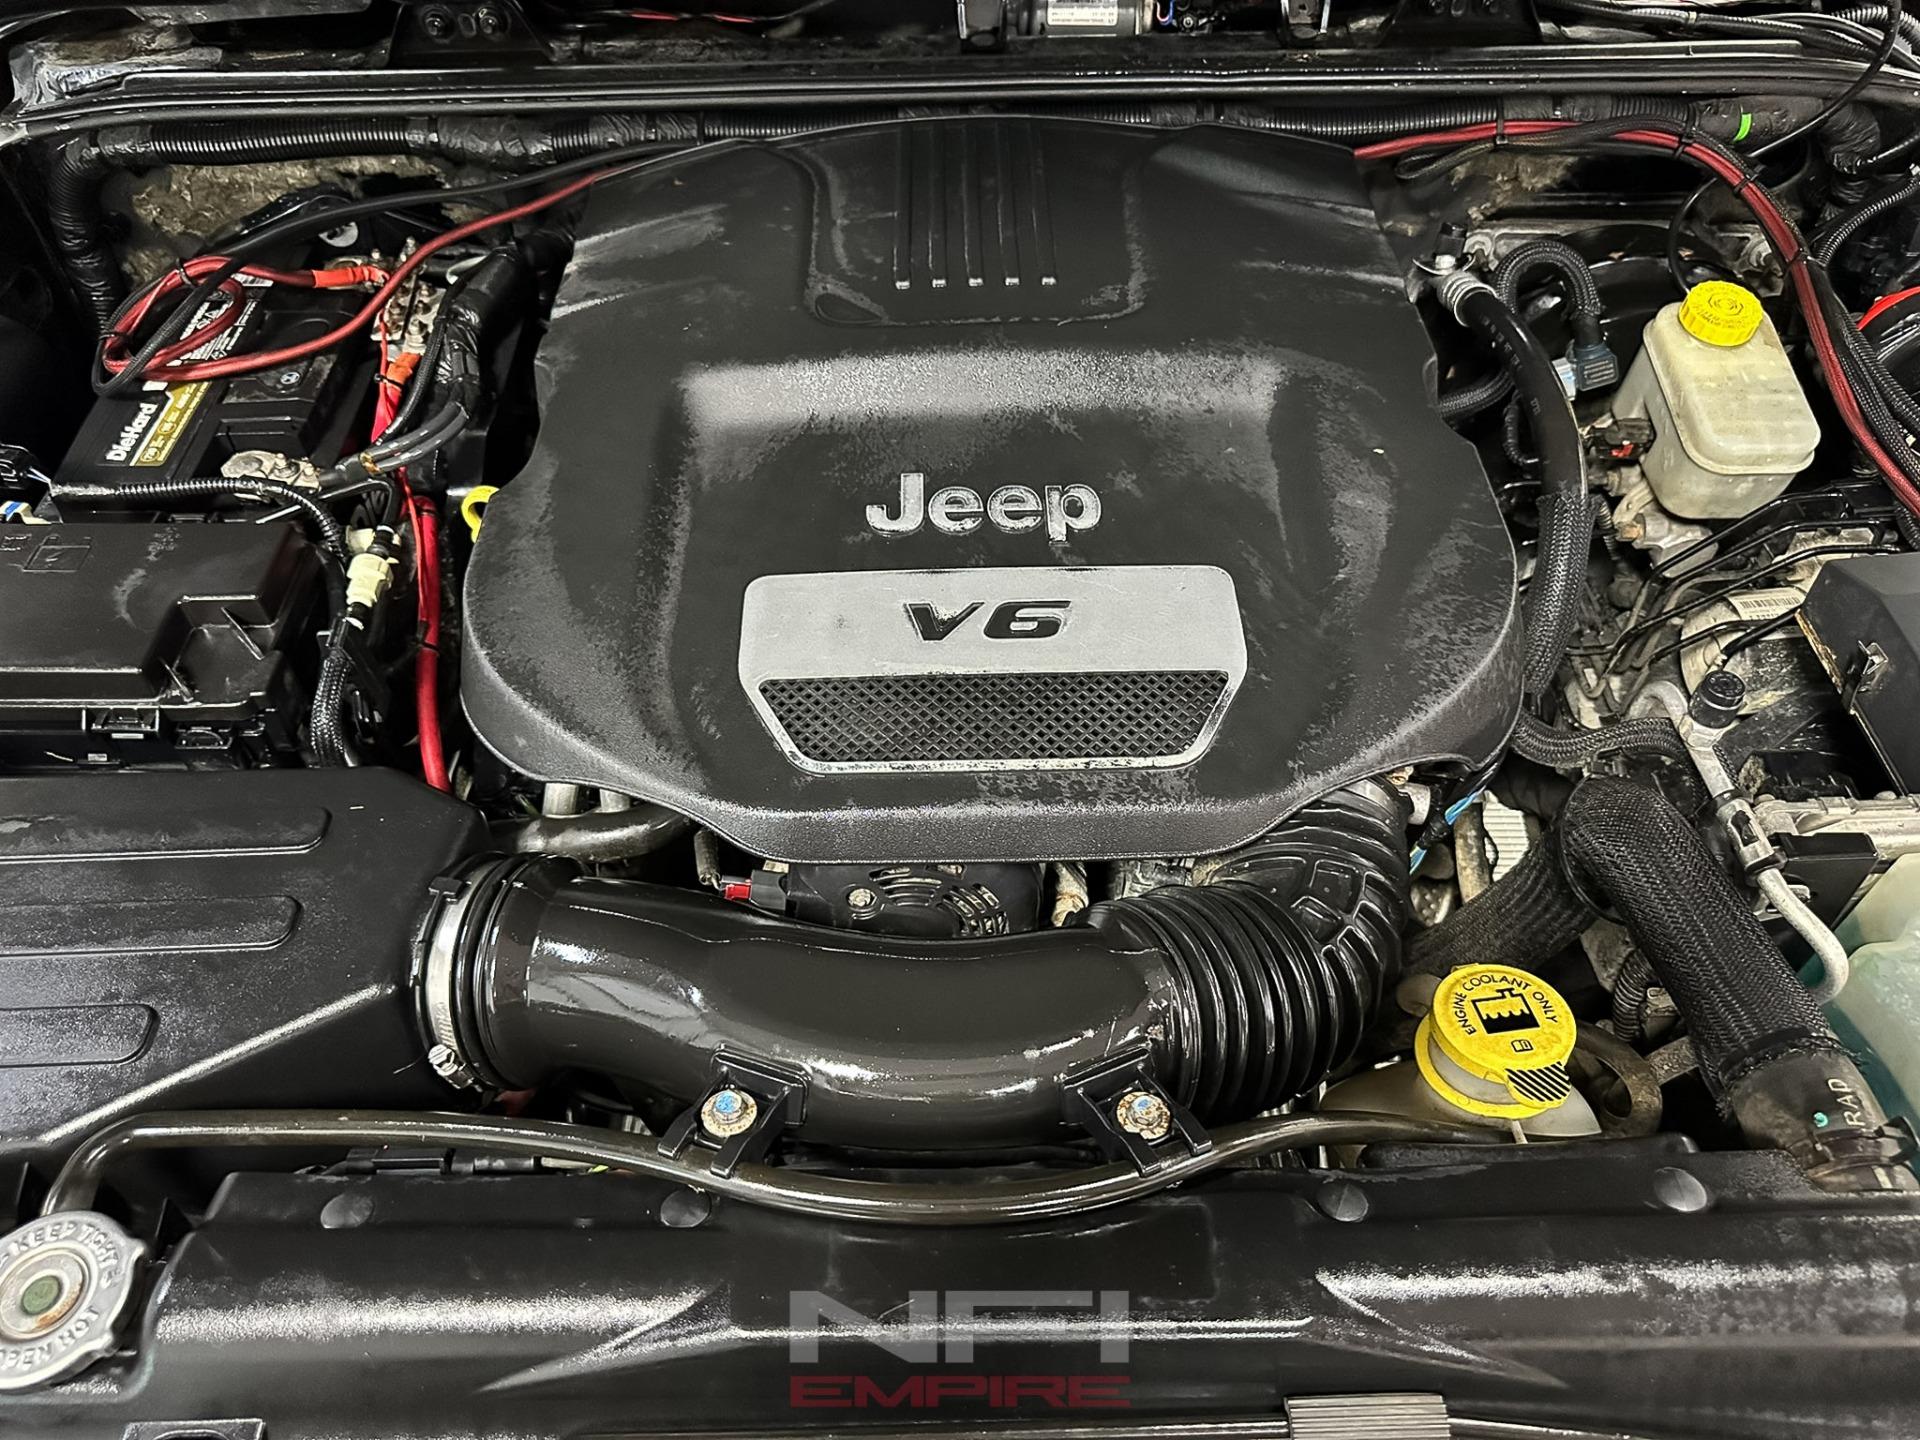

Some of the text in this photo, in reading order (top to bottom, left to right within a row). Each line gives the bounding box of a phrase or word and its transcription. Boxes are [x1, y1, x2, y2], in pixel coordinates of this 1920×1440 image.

[105, 402, 159, 461] DieHard
[865, 472, 1102, 544] Jeep
[904, 600, 1072, 641] V6
[1453, 974, 1558, 1035] ENGINE COOLANT ONLY
[1828, 1078, 1866, 1127] RAD
[9, 1221, 77, 1254] KEEP
[57, 1305, 99, 1350] HOT
